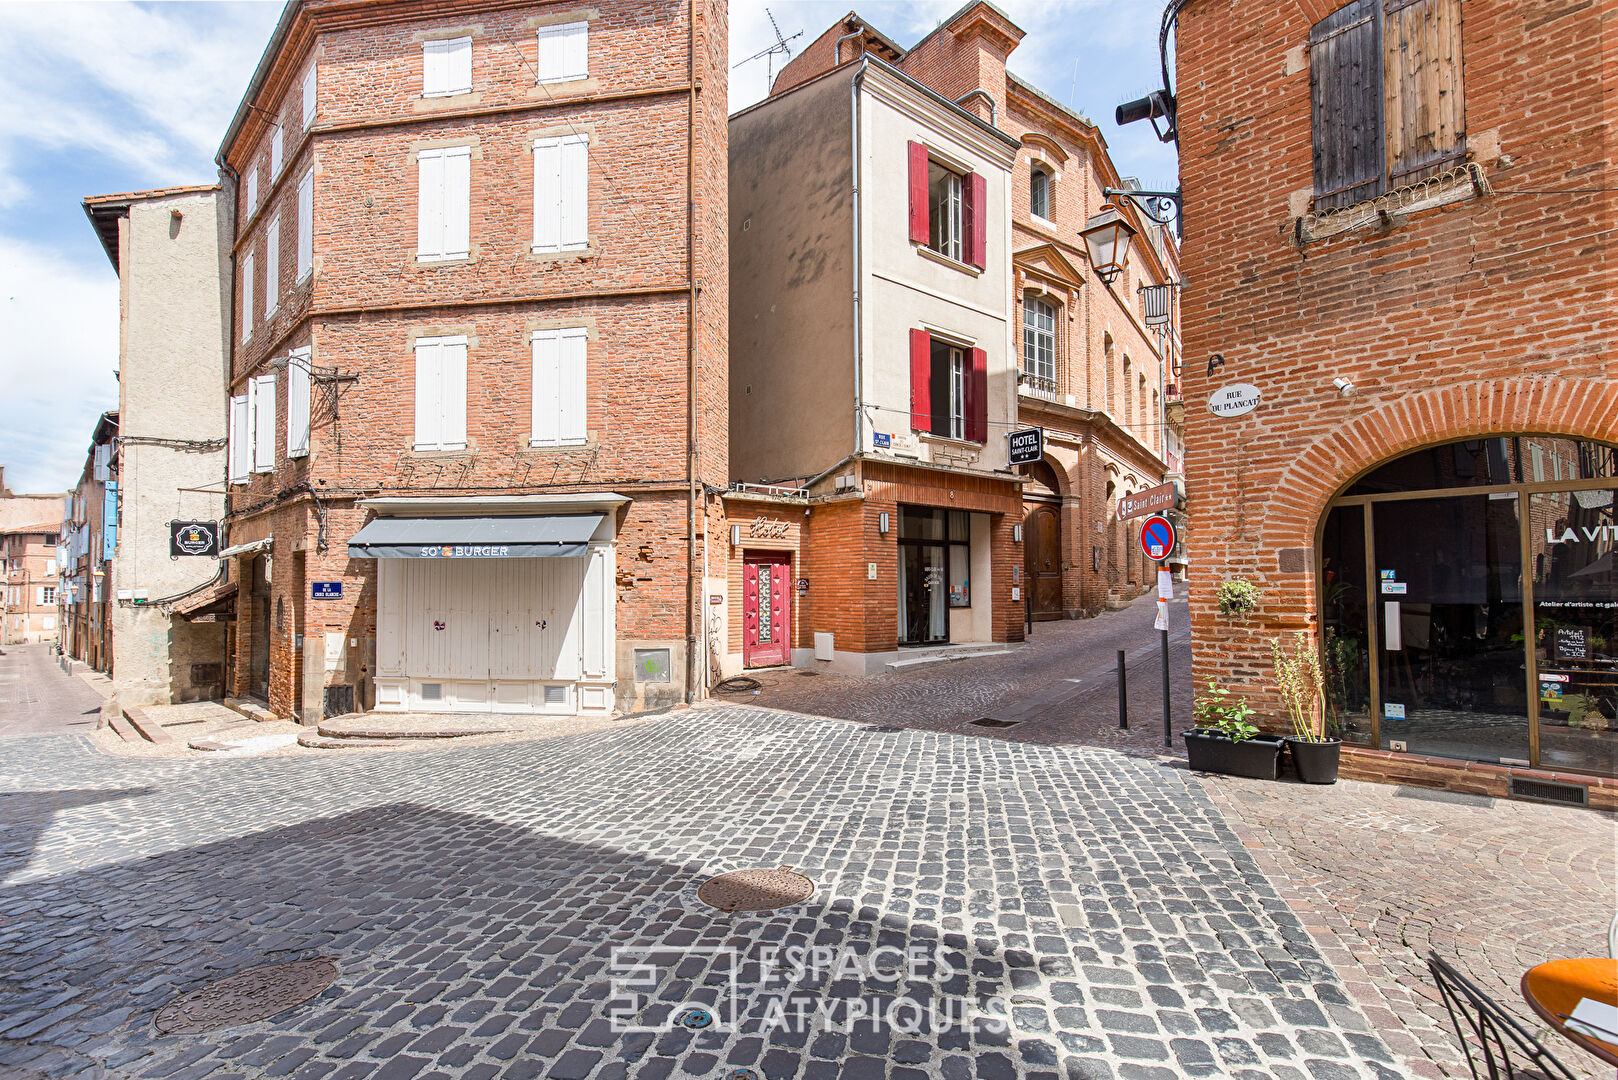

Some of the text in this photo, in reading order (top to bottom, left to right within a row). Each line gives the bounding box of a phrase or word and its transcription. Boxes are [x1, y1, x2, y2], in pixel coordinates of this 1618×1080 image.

[1226, 390, 1242, 400] RUE
[1212, 398, 1258, 412] DU PLANCAT
[1012, 434, 1037, 447] HOTEL
[1011, 445, 1038, 455] SAINT-CLAIR
[1133, 493, 1165, 511] Saint Clair
[750, 515, 791, 539] Hotel
[1546, 527, 1580, 544] LA
[421, 545, 508, 557] SO' BURGER
